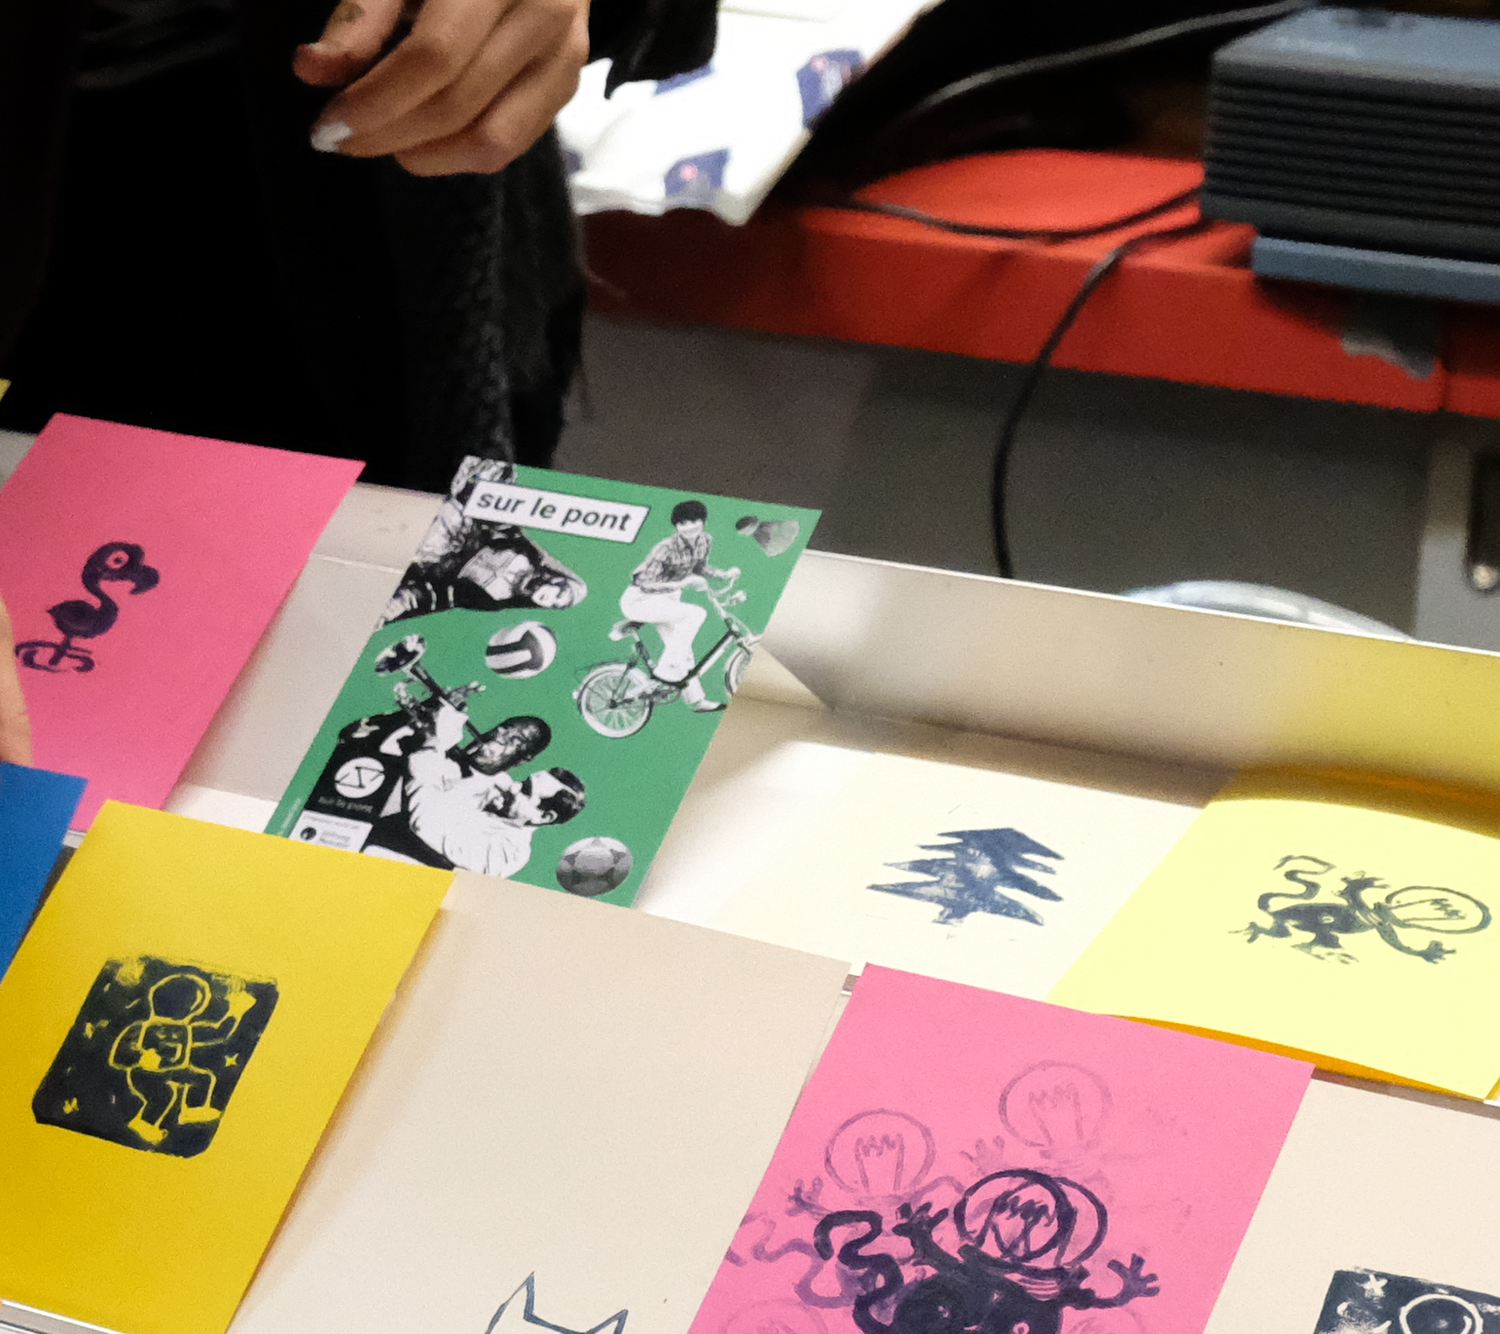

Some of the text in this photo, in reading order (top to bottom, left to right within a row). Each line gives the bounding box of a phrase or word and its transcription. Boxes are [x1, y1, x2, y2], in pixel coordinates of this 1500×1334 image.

[476, 492, 633, 532] sur le pont
